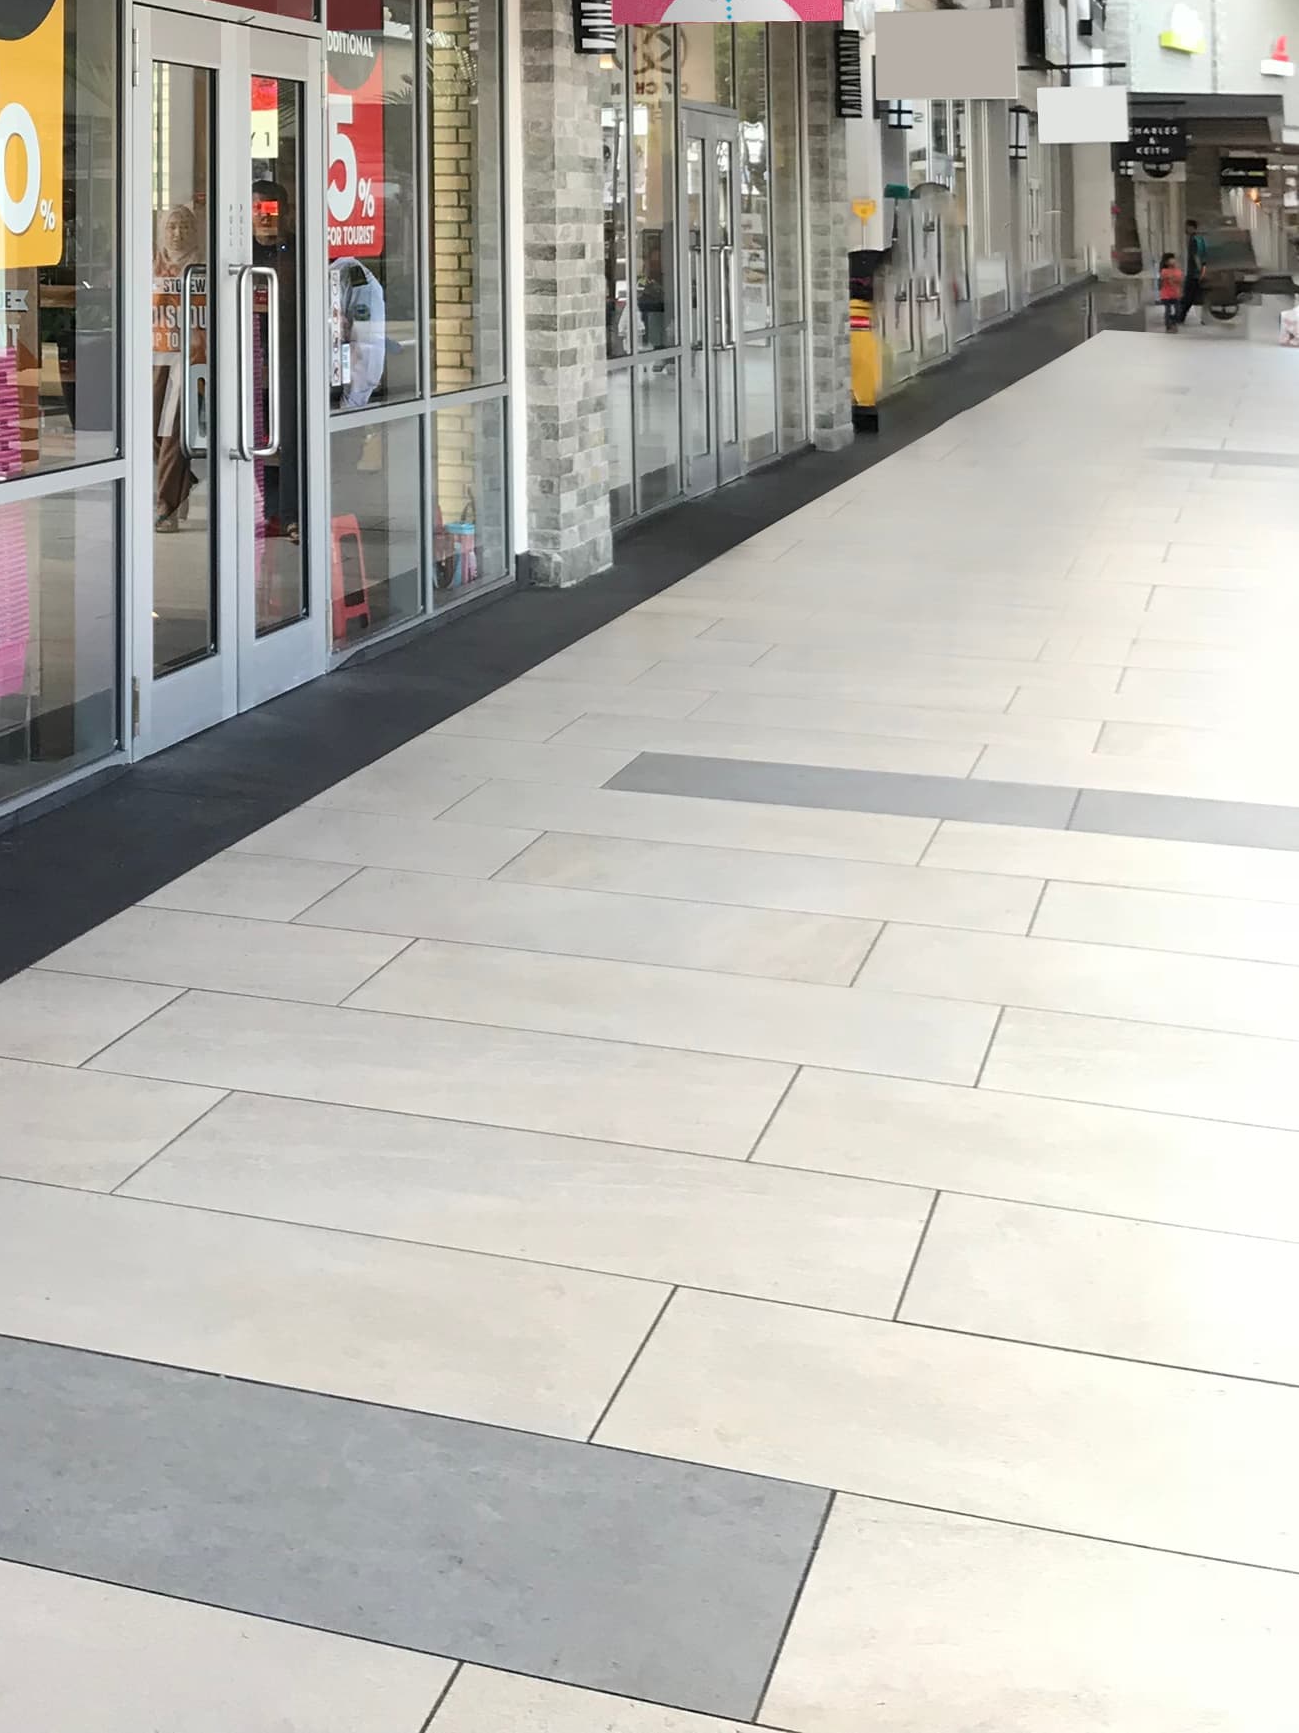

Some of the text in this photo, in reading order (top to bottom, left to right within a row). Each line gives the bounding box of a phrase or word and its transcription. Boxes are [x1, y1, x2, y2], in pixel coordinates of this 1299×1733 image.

[327, 30, 374, 57] DDITIONAL
[343, 225, 375, 245] TOURIST
[164, 279, 206, 293] STOEW
